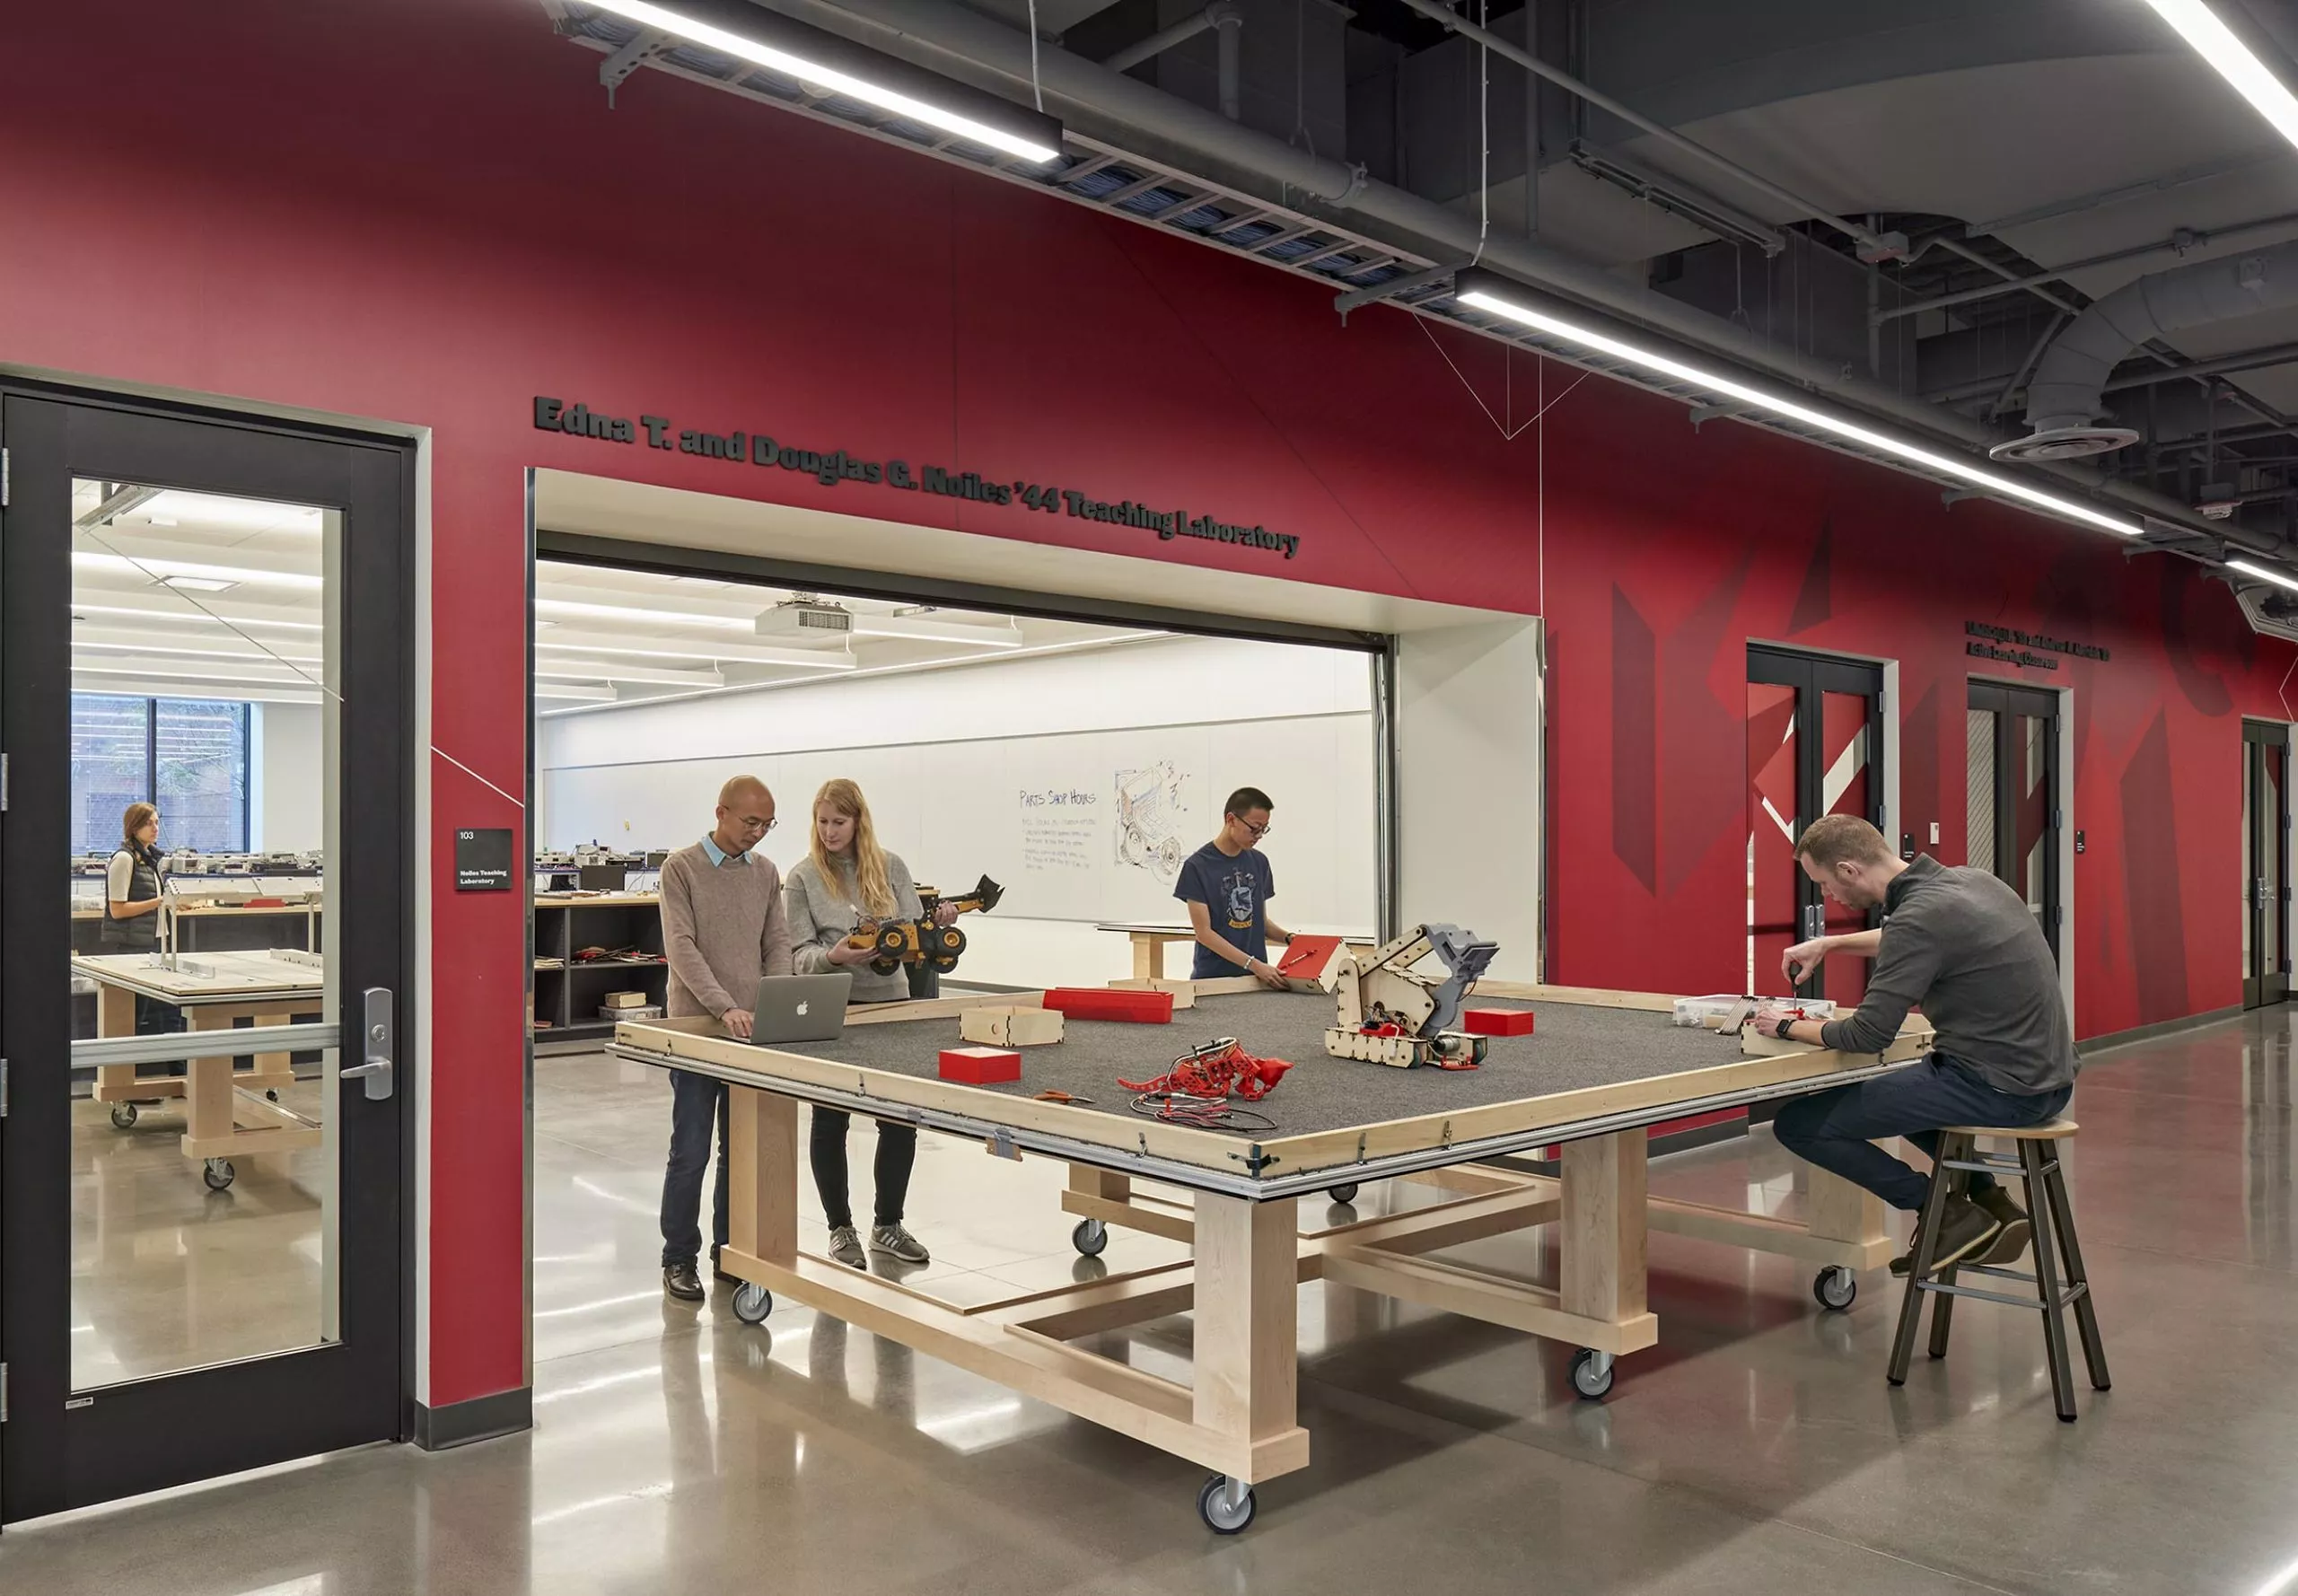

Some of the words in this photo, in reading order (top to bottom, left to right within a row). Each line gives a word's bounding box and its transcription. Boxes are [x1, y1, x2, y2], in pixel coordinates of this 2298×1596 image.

[534, 397, 635, 443] Edna
[641, 416, 672, 449] T.
[680, 432, 745, 461] and
[752, 435, 882, 486] Douglas
[887, 460, 918, 490] G.
[924, 465, 1011, 505] Noiles
[1064, 490, 1175, 540] Teaching
[1176, 510, 1300, 559] Laboratory
[460, 831, 474, 840] 103
